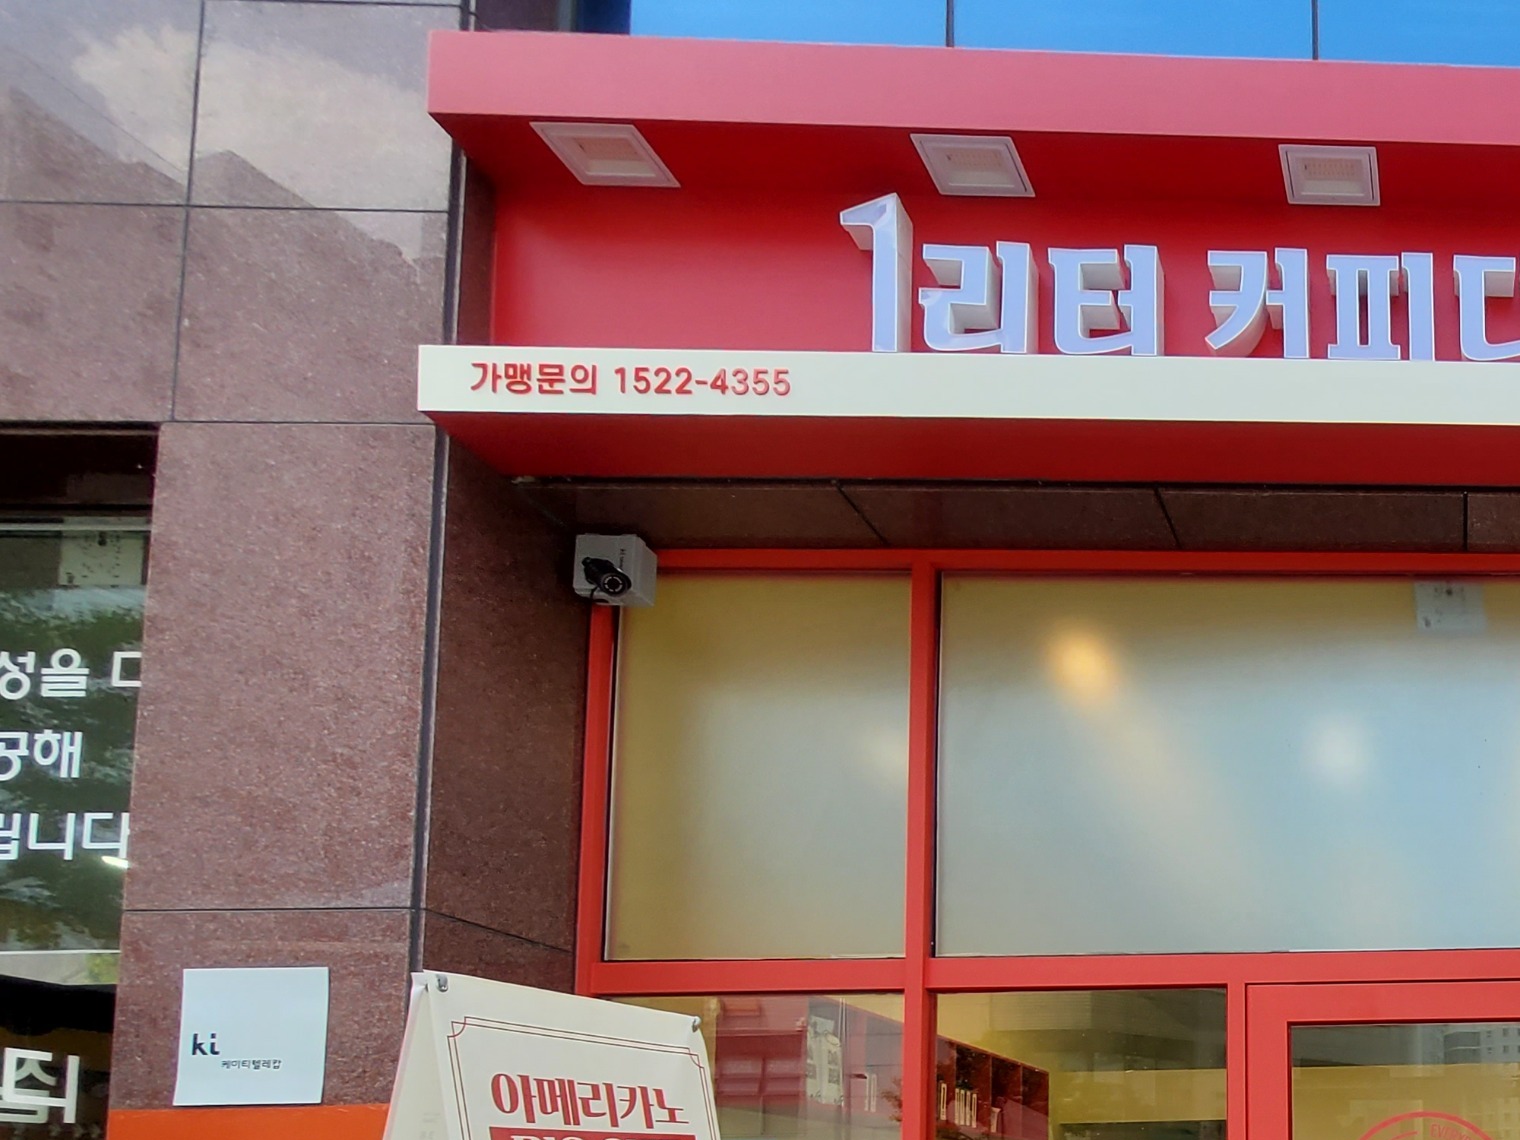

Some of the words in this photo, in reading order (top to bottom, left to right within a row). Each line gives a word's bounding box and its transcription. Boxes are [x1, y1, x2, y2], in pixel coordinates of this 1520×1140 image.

[840, 193, 1163, 355] 1리터
[470, 362, 598, 395] 가맹문의
[614, 365, 792, 397] 1522-4355
[490, 1073, 690, 1130] 아메리카노
